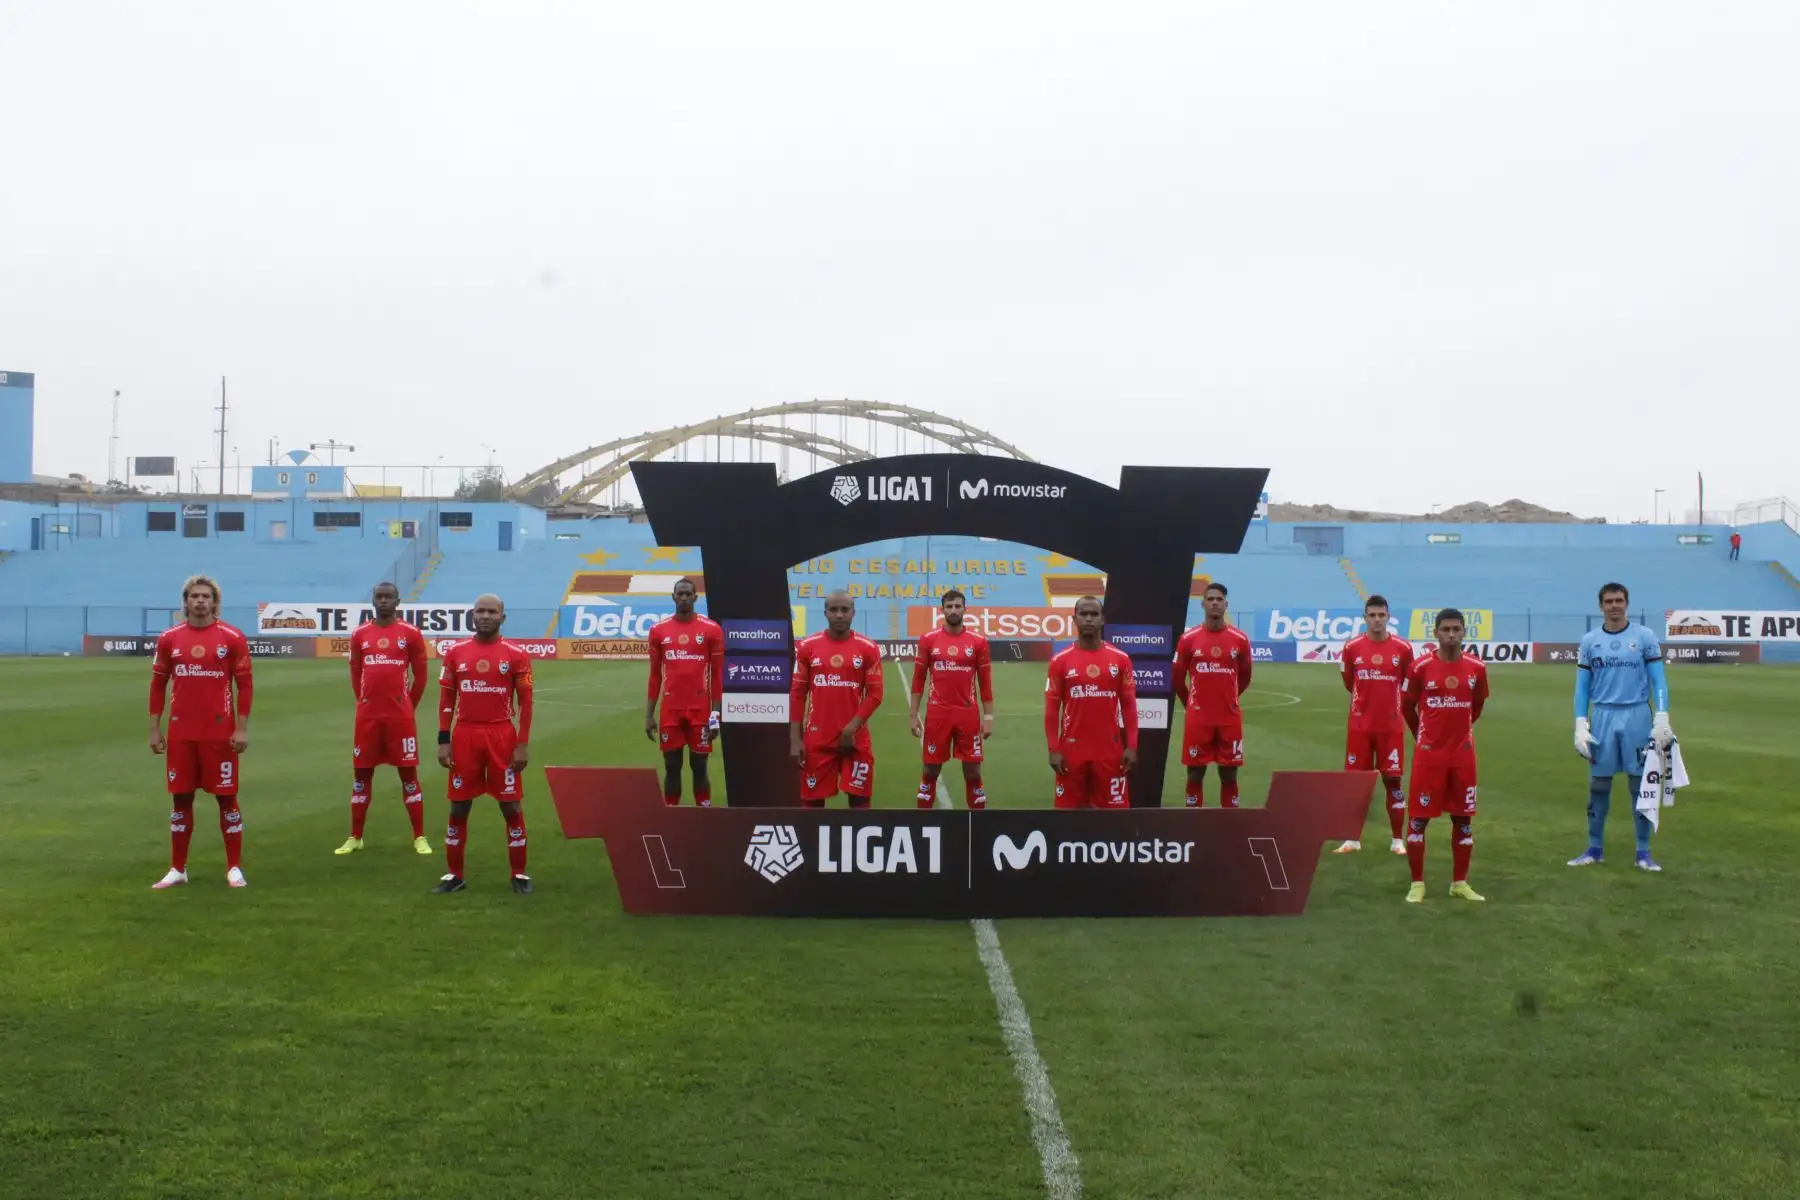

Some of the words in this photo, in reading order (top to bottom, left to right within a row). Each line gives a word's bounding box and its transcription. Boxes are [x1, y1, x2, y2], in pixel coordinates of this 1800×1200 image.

[993, 483, 1067, 498] movistar
[946, 559, 1028, 576] URIBE
[317, 608, 348, 631] TE
[1722, 615, 1751, 637] TE
[728, 629, 781, 640] marathon
[1112, 634, 1165, 645] marathon
[741, 665, 781, 673] LATAM
[727, 702, 784, 715] betsson
[402, 737, 416, 753] 18
[1388, 748, 1399, 764] 4
[220, 761, 233, 778] 9
[851, 760, 869, 781] 12
[1110, 776, 1127, 796] 27
[1057, 838, 1195, 863] movistar
